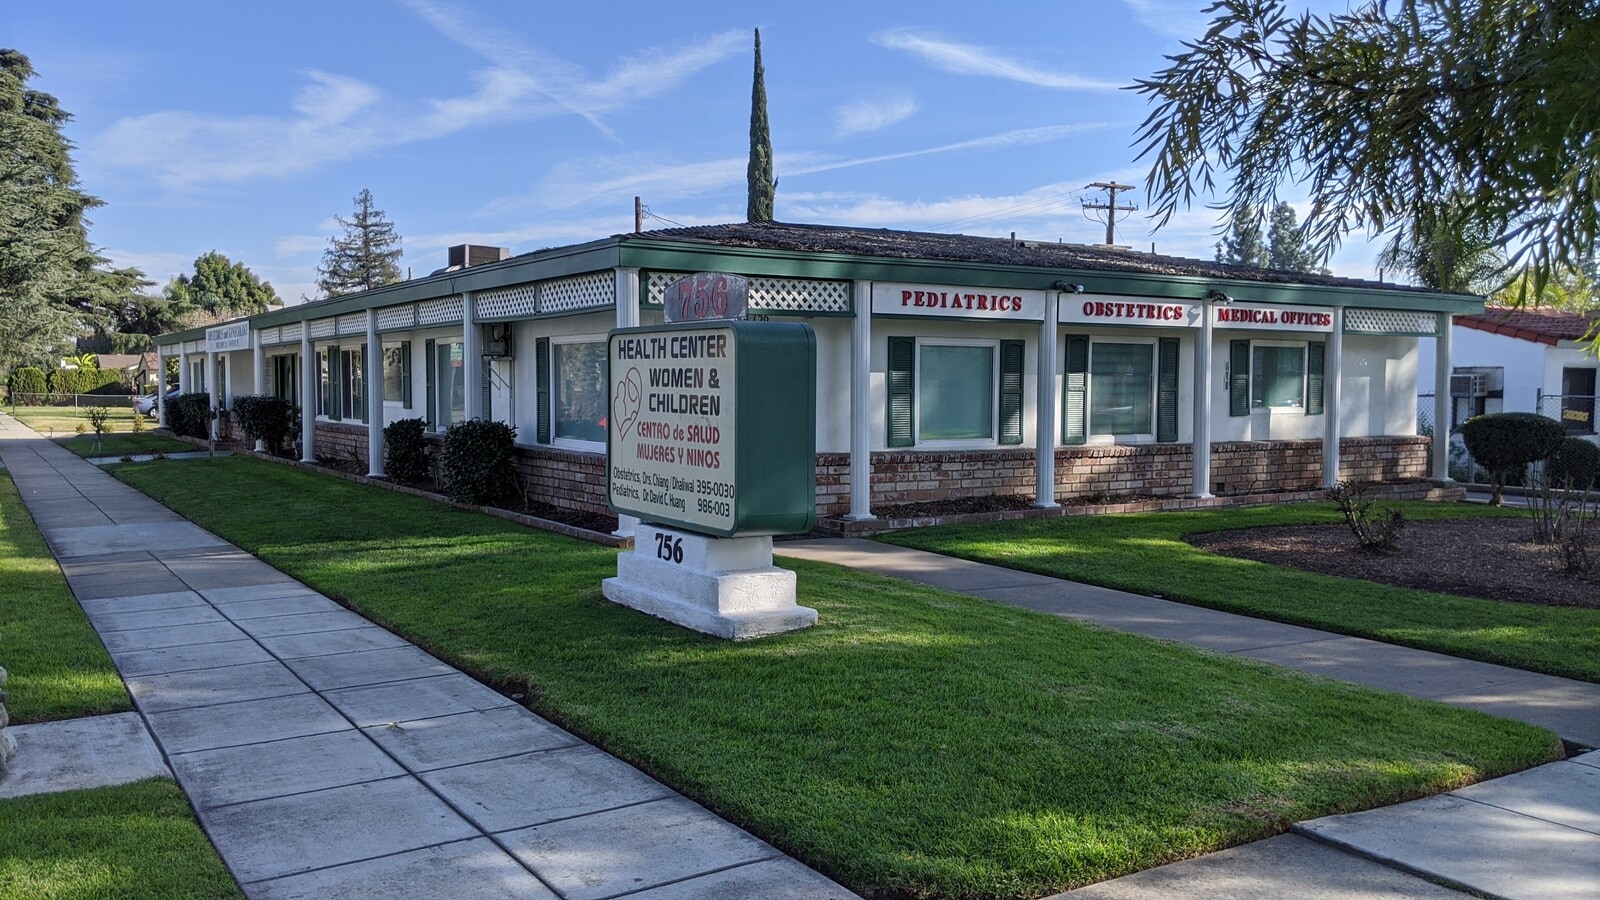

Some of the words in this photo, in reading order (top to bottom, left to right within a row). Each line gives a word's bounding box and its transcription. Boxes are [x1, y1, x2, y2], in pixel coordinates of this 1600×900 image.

[678, 277, 728, 319] 756
[901, 290, 1022, 312] PEDIATRICS
[1083, 302, 1183, 320] OBSTETRICS
[1217, 308, 1278, 324] MEDICAL
[1281, 310, 1331, 326] OFFICES
[618, 338, 667, 360] HEALTH
[670, 334, 727, 359] CENTER
[648, 368, 704, 389] WOMEN
[708, 368, 720, 389] &
[648, 393, 721, 416] CHILDREN
[636, 421, 671, 440] CENTRO
[673, 424, 685, 441] de
[687, 425, 720, 444] SALUD
[636, 442, 675, 463] MUJERES
[678, 447, 684, 465] Y
[686, 448, 720, 469] NINOS
[653, 473, 669, 491] Chiang
[672, 476, 695, 493] Dhaliwal
[696, 479, 735, 499] 395-0030
[669, 493, 685, 512] Huang
[697, 498, 730, 518] 986-003
[654, 532, 683, 564] 756
